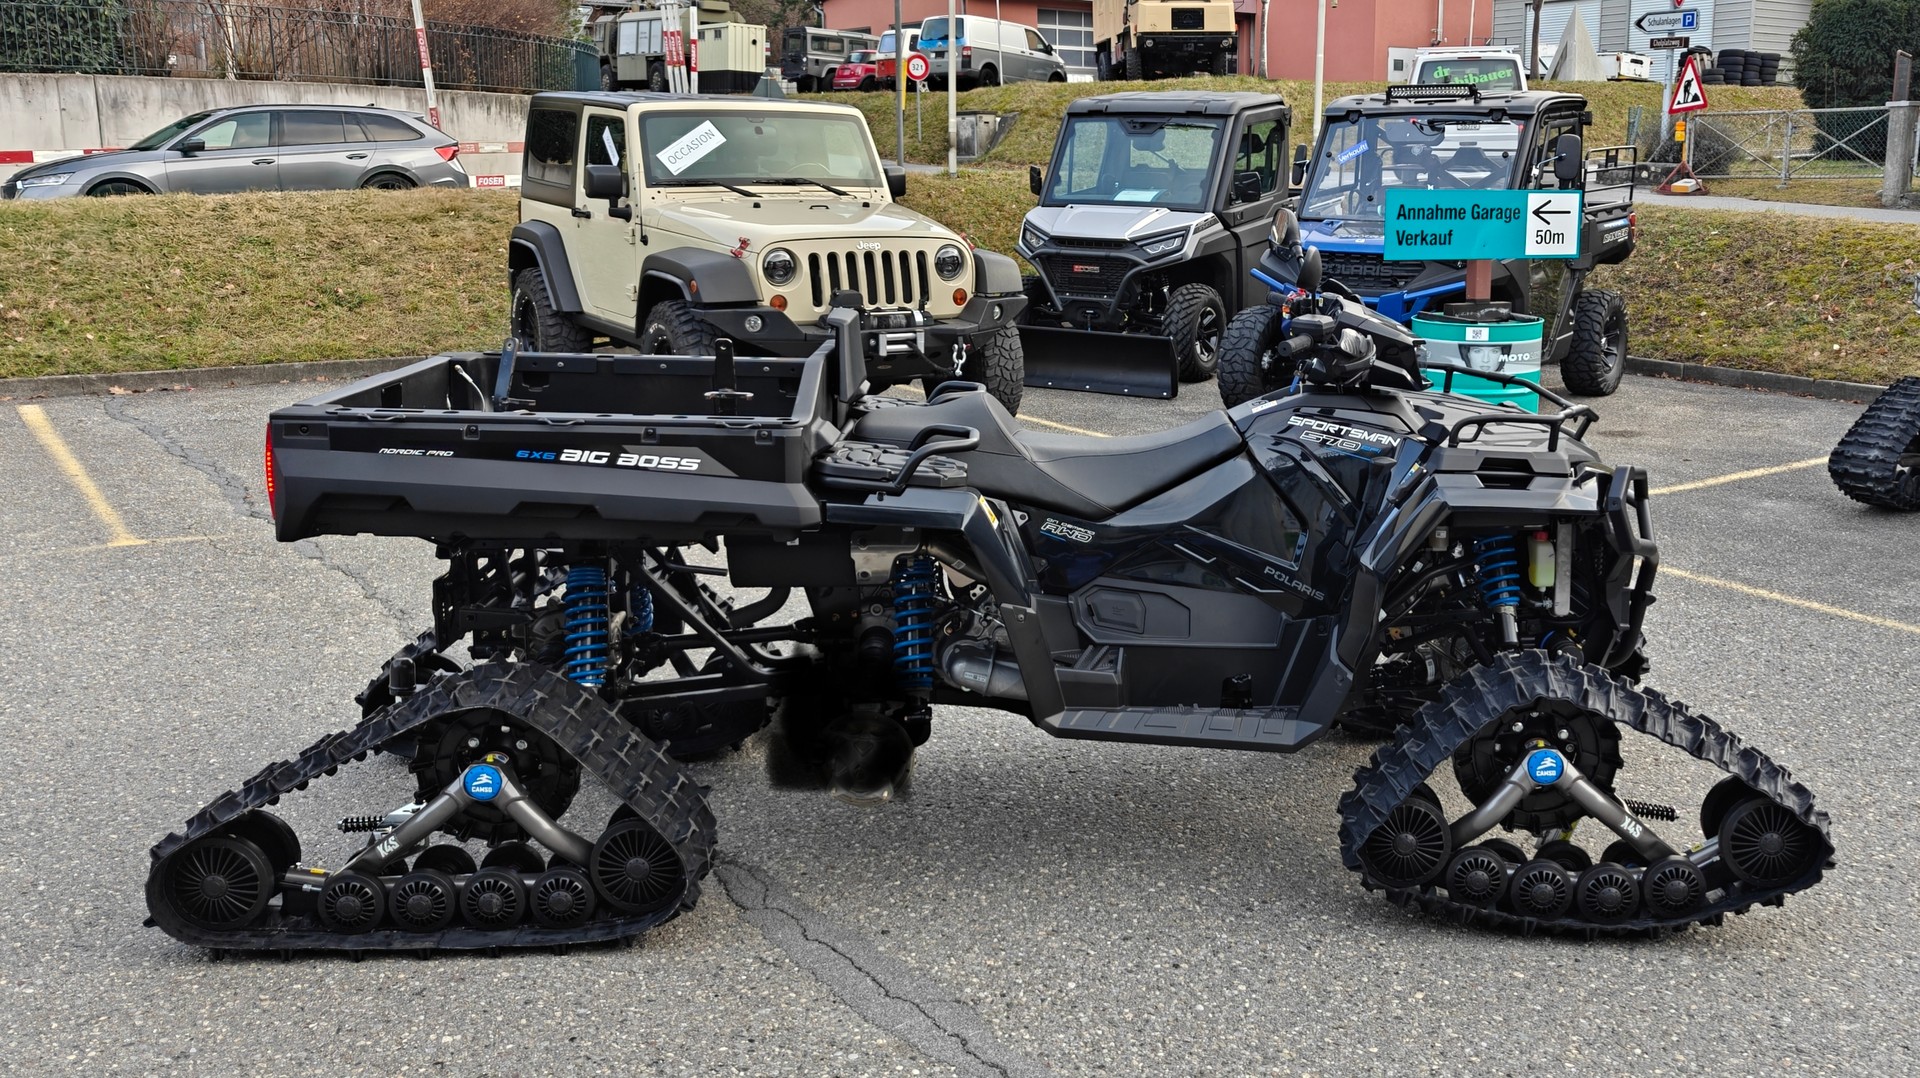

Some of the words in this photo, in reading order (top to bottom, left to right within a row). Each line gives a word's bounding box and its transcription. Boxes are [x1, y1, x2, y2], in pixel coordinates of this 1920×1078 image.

[1648, 17, 1682, 27] Schulanlagen
[1685, 15, 1692, 26] P
[1433, 65, 1451, 79] dr
[667, 129, 715, 165] OCCASION
[478, 177, 504, 186] FOSER
[1396, 204, 1466, 220] Annahme
[1471, 203, 1521, 223] Garage
[856, 240, 881, 251] Jeep
[1396, 229, 1453, 246] Verkauf
[1535, 229, 1565, 245] 50m
[1288, 415, 1401, 447] SPORTSMAN
[1300, 431, 1361, 451] 570
[560, 449, 611, 464] BIG
[617, 453, 702, 471] BOSS
[1040, 522, 1093, 543] AWD
[1264, 566, 1325, 601] POLARIS
